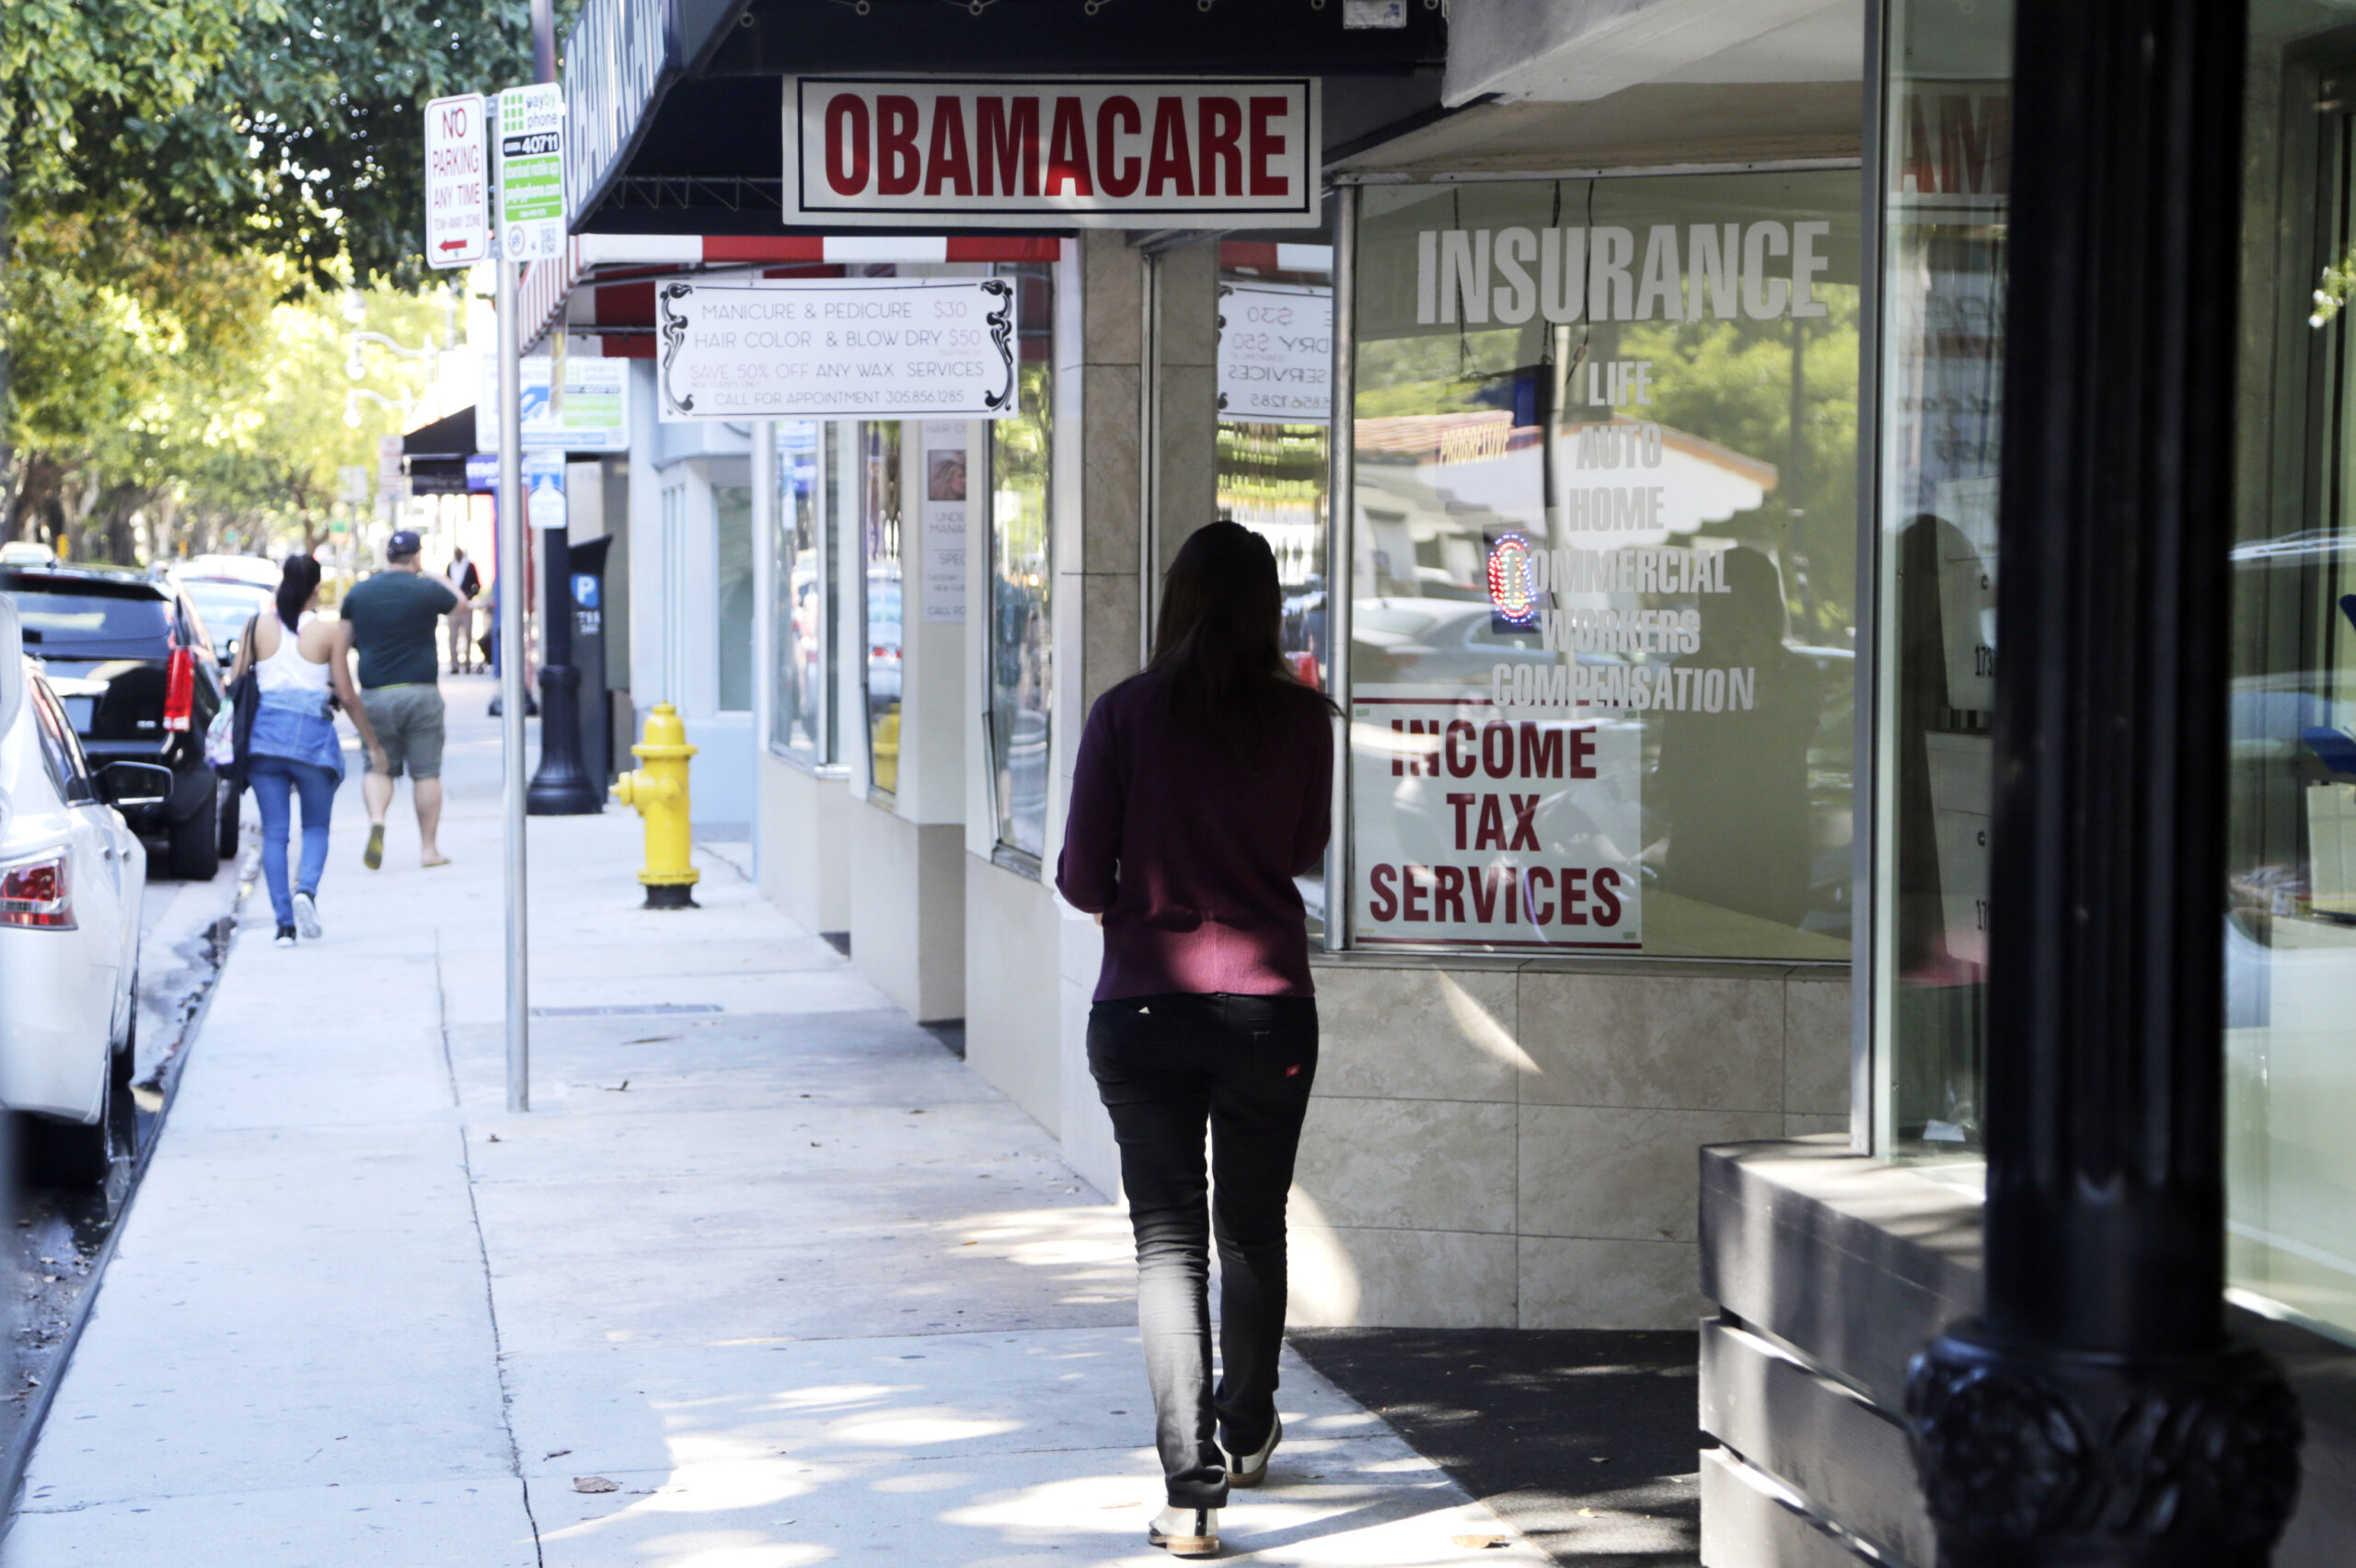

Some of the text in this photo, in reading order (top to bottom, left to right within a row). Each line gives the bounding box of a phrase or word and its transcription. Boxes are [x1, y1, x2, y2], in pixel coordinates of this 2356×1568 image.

[443, 108, 467, 139] NO
[522, 133, 559, 155] 40711
[527, 112, 558, 131] phone
[433, 144, 479, 179] PARKING
[825, 93, 1288, 198] OBAMACARE
[433, 183, 480, 209] ANY TIME
[1417, 220, 1831, 326] INSURANCE
[701, 301, 968, 320] MANICURE & PEDICURE $30
[694, 329, 982, 349] HAIR COLOR & BLOW DRY $50
[690, 361, 985, 380] SAVE 50% OFF ANY WAX SERVICES
[1588, 361, 1653, 407] LIFE
[714, 392, 749, 407] CALL
[755, 391, 781, 405] FOR
[786, 390, 880, 406] APPOINTMENT
[1576, 423, 1662, 471] AUTO
[935, 511, 966, 523] UNDE
[1569, 486, 1665, 533] HOME
[1509, 548, 1731, 594] COMMERCIAL
[1541, 609, 1701, 654] WORKERS
[1492, 663, 1755, 713] COMPENSATION
[1392, 719, 1597, 778] INCOME
[1446, 792, 1542, 851] TAX
[1369, 863, 1622, 927] SERVICES
